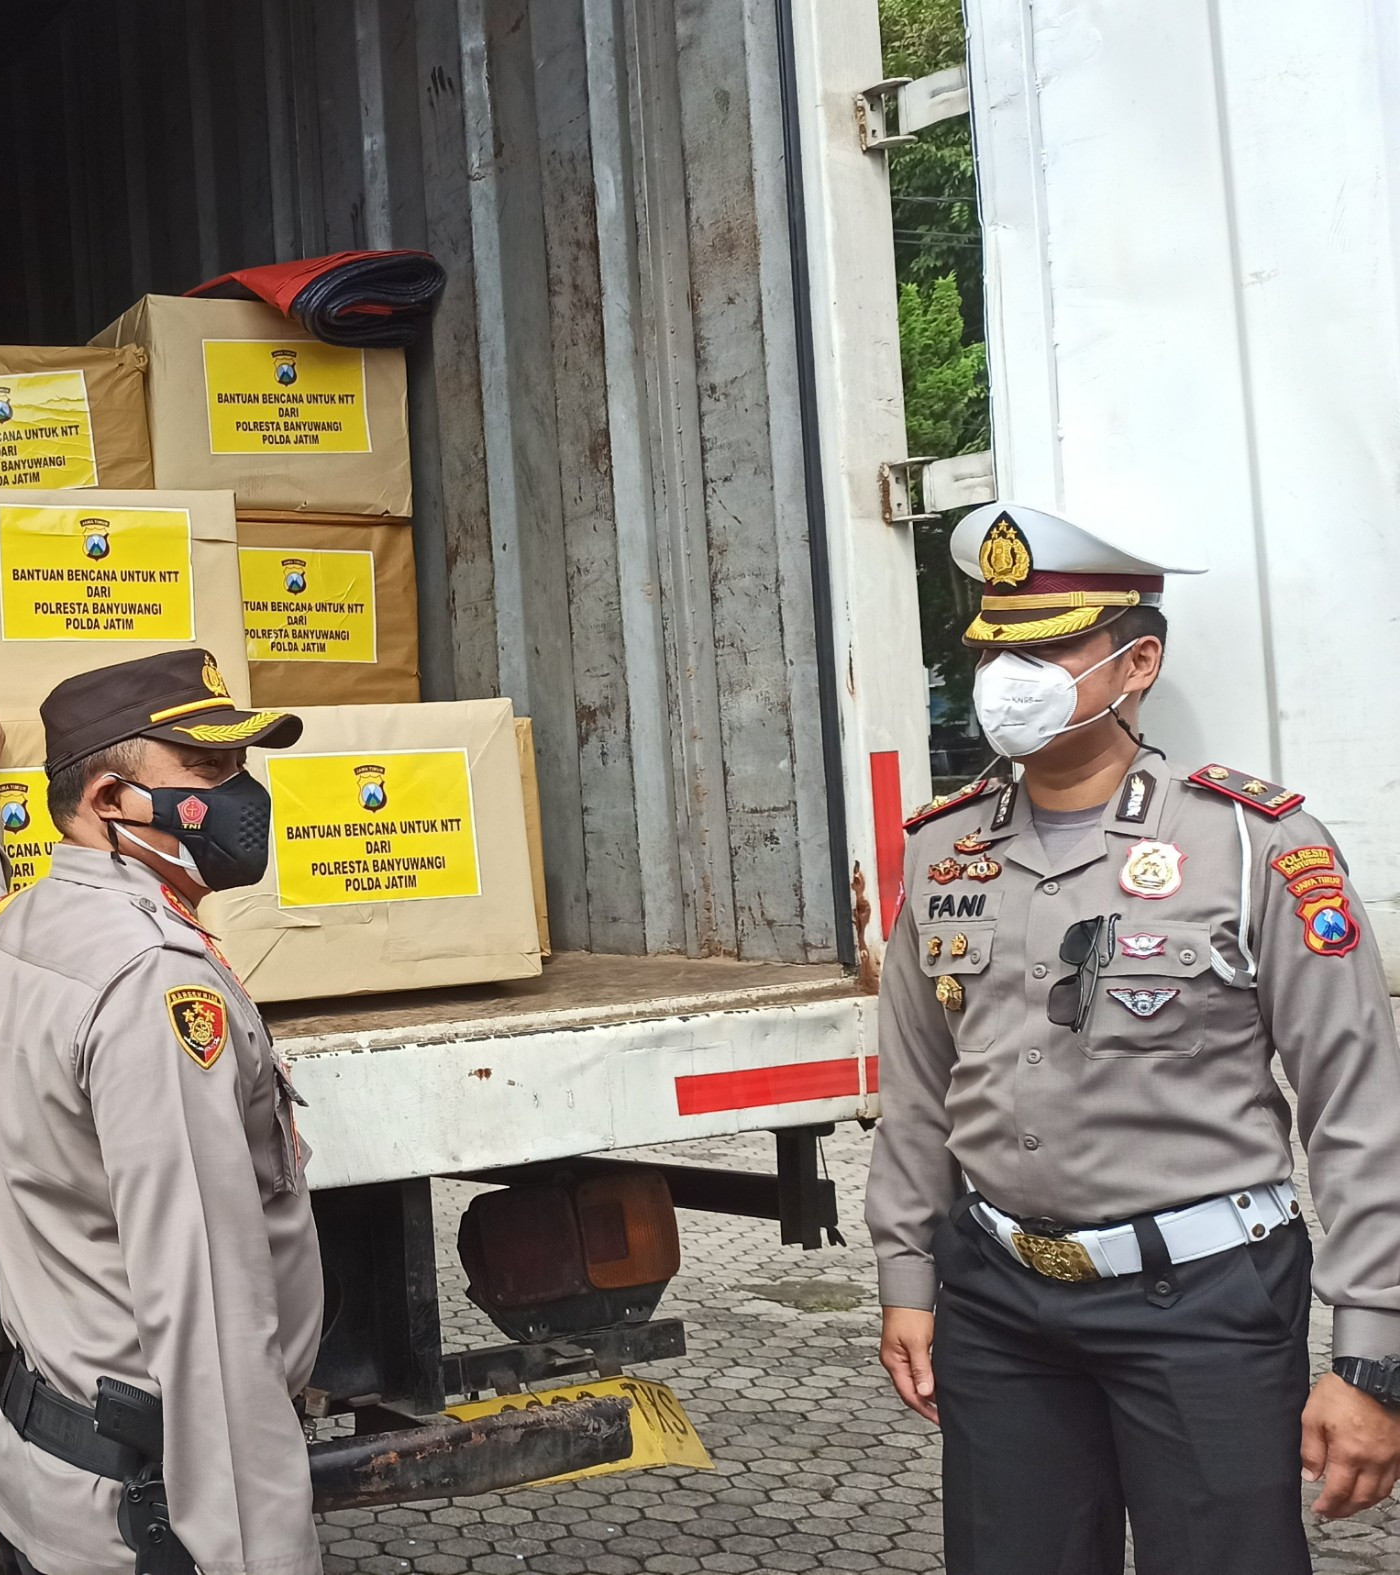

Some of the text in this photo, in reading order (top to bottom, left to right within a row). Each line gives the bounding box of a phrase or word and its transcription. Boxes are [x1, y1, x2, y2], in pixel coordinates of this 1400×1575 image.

[217, 393, 355, 404] BANTUAN BENCANA UNTUK NTT
[278, 408, 299, 418] DARI
[236, 421, 342, 431] POLRESTA BANYUWANGI
[25, 427, 58, 441] UNTUK
[61, 425, 79, 437] NTT
[262, 434, 319, 444] POLDA JATIM
[1, 456, 65, 472] BANYUWANGI
[12, 471, 40, 485] JATIM
[12, 569, 179, 582] BANTUAN BENCANA UNTUK NTT
[86, 586, 110, 598] DARI
[34, 602, 162, 615] POLRESTA BANYUWANGI
[271, 602, 313, 612] BENCANA
[315, 602, 344, 613] UNTUK
[348, 603, 364, 614] NTT
[66, 618, 134, 630] POLDA JATIM
[287, 616, 307, 626] DARI
[245, 629, 349, 640] POLRESTA BANYUWANGI
[271, 642, 326, 652] POLDA JATIM
[286, 819, 461, 840] BANTUAN BENCANA UNTUK NTT
[366, 840, 390, 854] DARI
[1278, 849, 1330, 868] POLRESTA
[312, 856, 445, 876] POLRESTA BANYUWANGI
[345, 875, 416, 891] POLDA JATIM
[1295, 878, 1318, 892] JAWA
[928, 894, 986, 920] FANI
